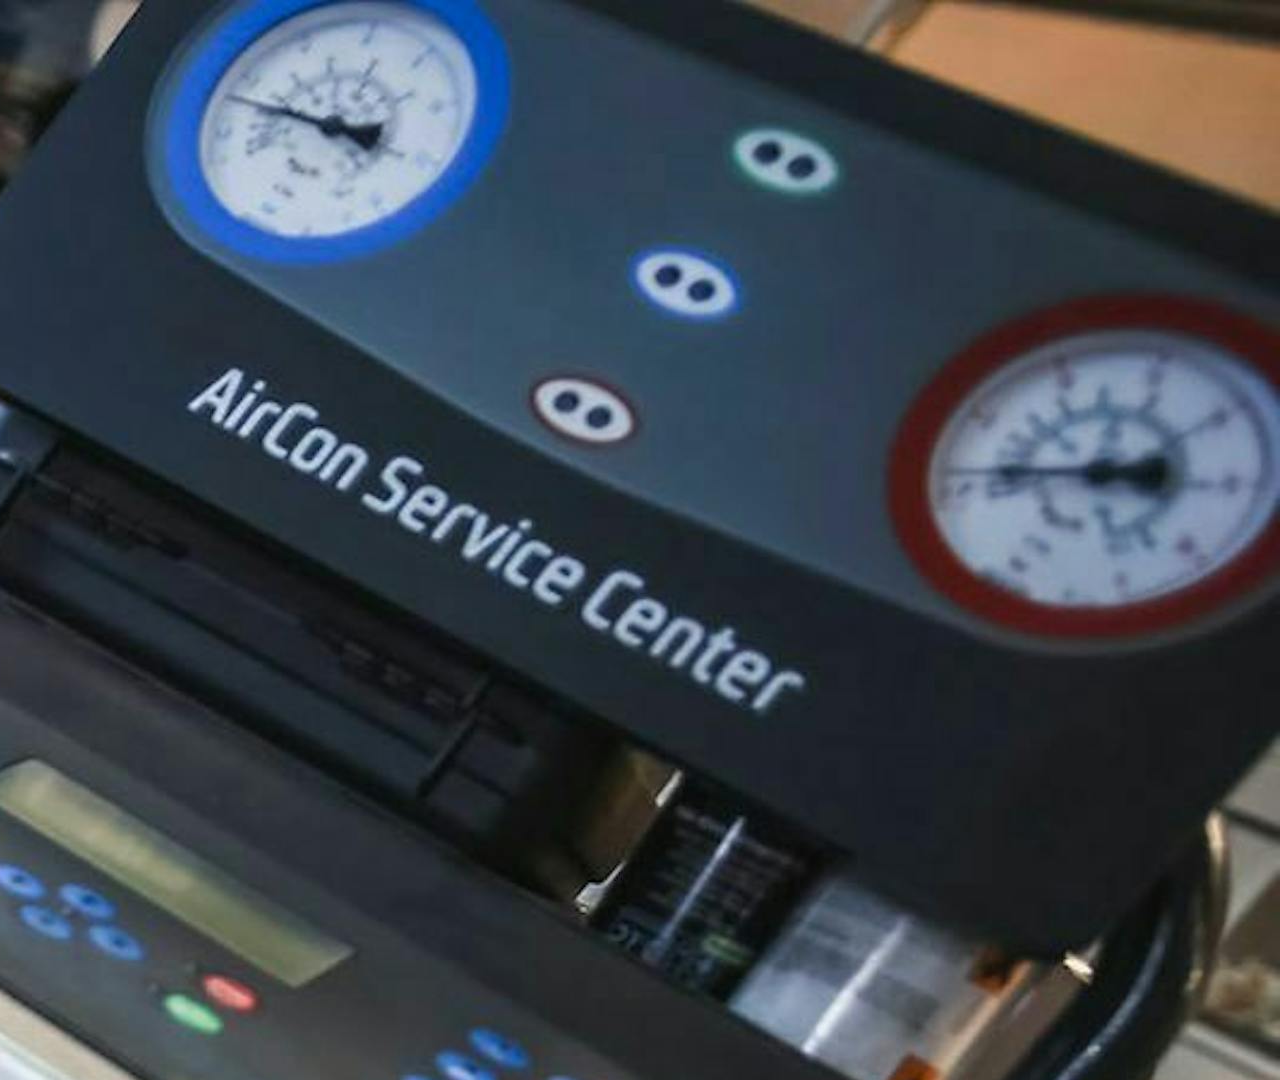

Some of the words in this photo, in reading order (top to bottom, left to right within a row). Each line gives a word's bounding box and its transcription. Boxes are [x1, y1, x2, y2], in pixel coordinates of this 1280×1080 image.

[187, 367, 369, 491] AirCon
[361, 455, 586, 605] Service
[582, 570, 804, 710] Center
